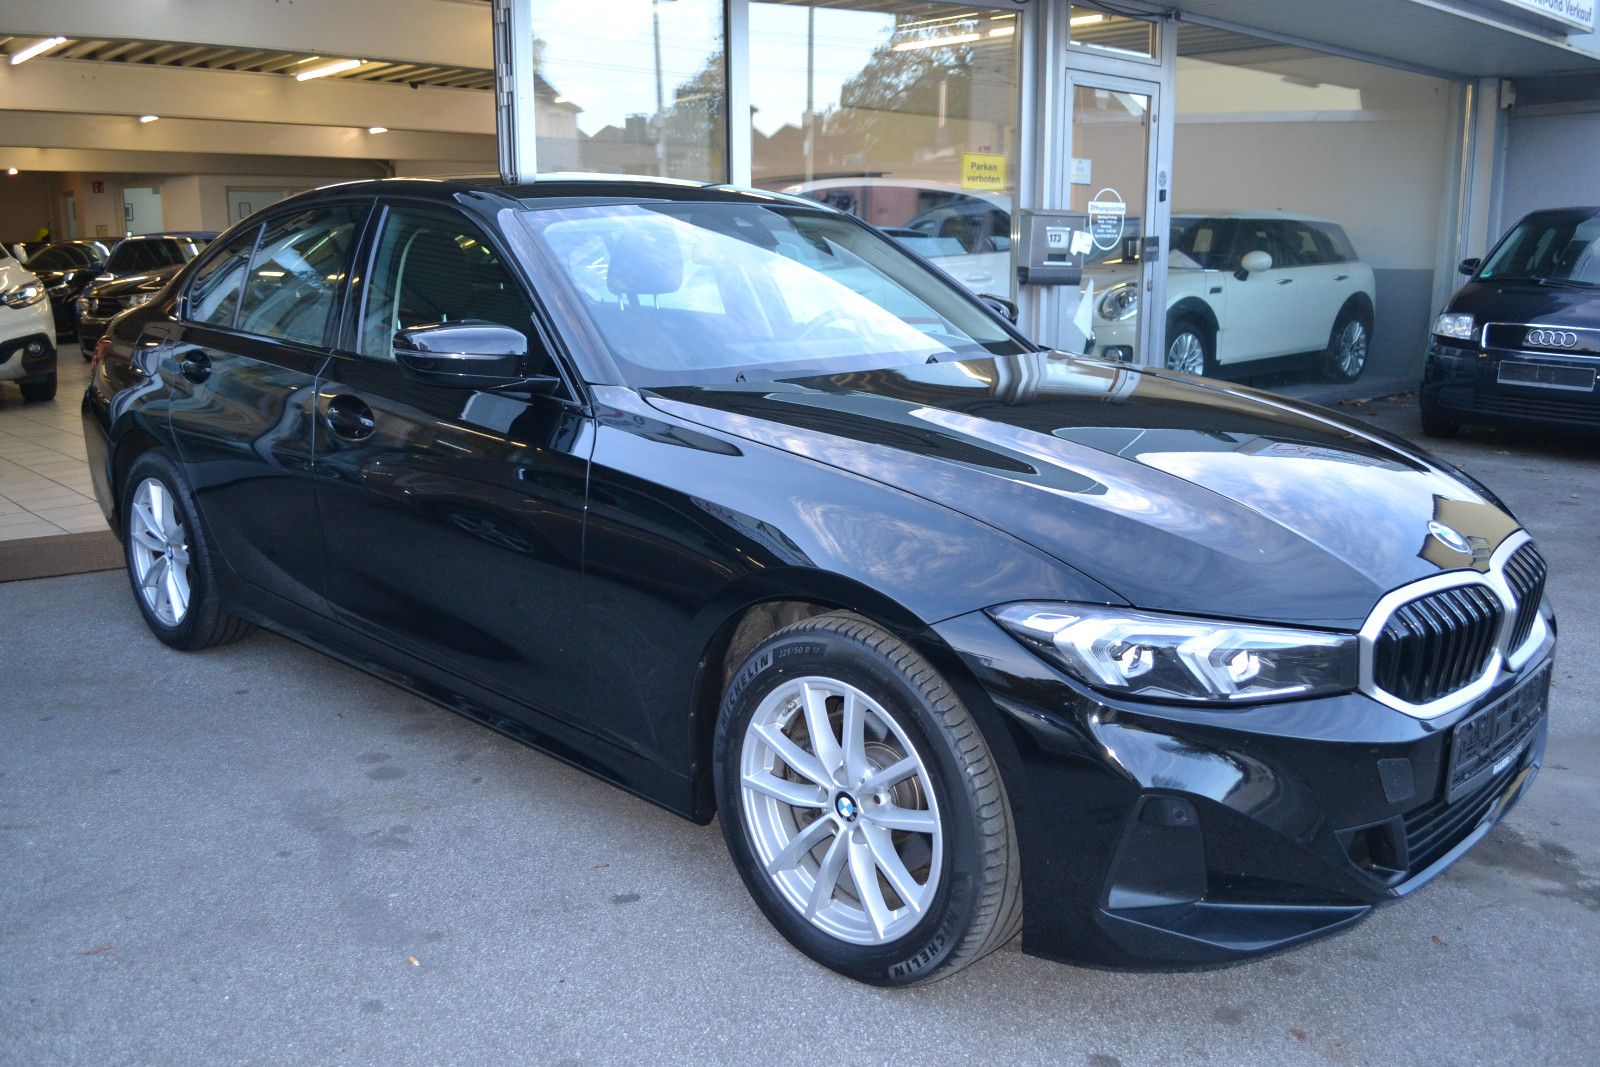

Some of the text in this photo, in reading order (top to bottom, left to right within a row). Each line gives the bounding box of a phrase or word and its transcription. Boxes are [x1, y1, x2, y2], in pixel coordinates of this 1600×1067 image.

[1565, 0, 1593, 22] Verkauf
[970, 161, 998, 171] Parken
[966, 174, 1001, 183] verboten
[1050, 233, 1062, 243] 173
[719, 653, 769, 730] MICHELIN
[893, 911, 959, 978] MICHELIN
